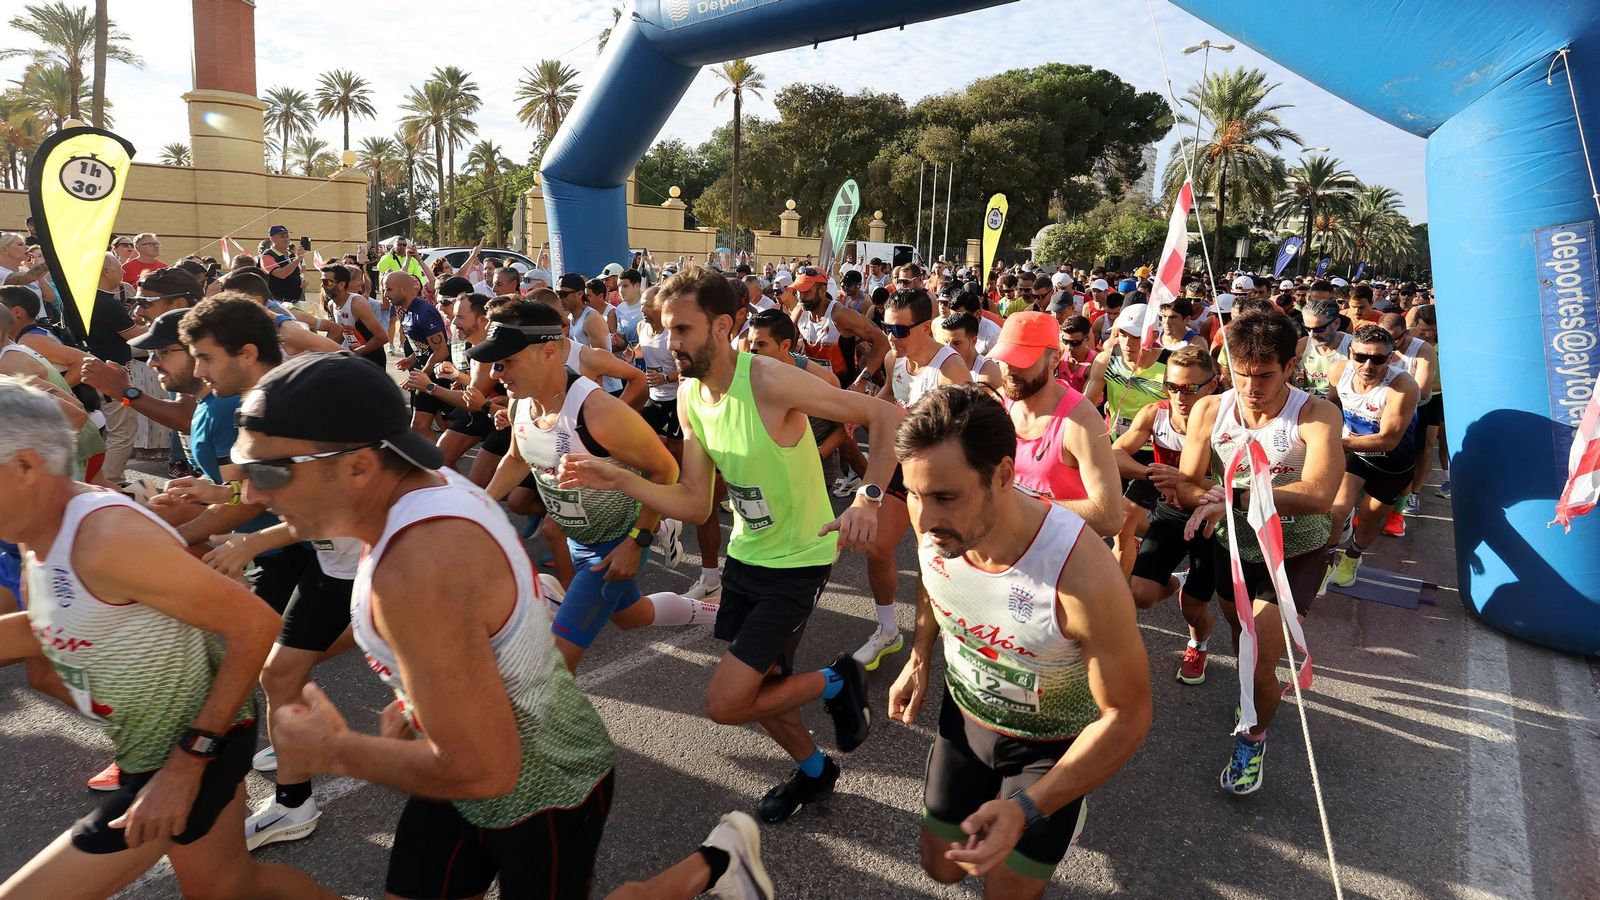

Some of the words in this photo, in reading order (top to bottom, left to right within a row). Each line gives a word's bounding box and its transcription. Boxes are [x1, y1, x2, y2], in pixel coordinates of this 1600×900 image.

[80, 161, 102, 178] 1h
[72, 180, 101, 196] 30'
[971, 669, 1002, 692] 12
